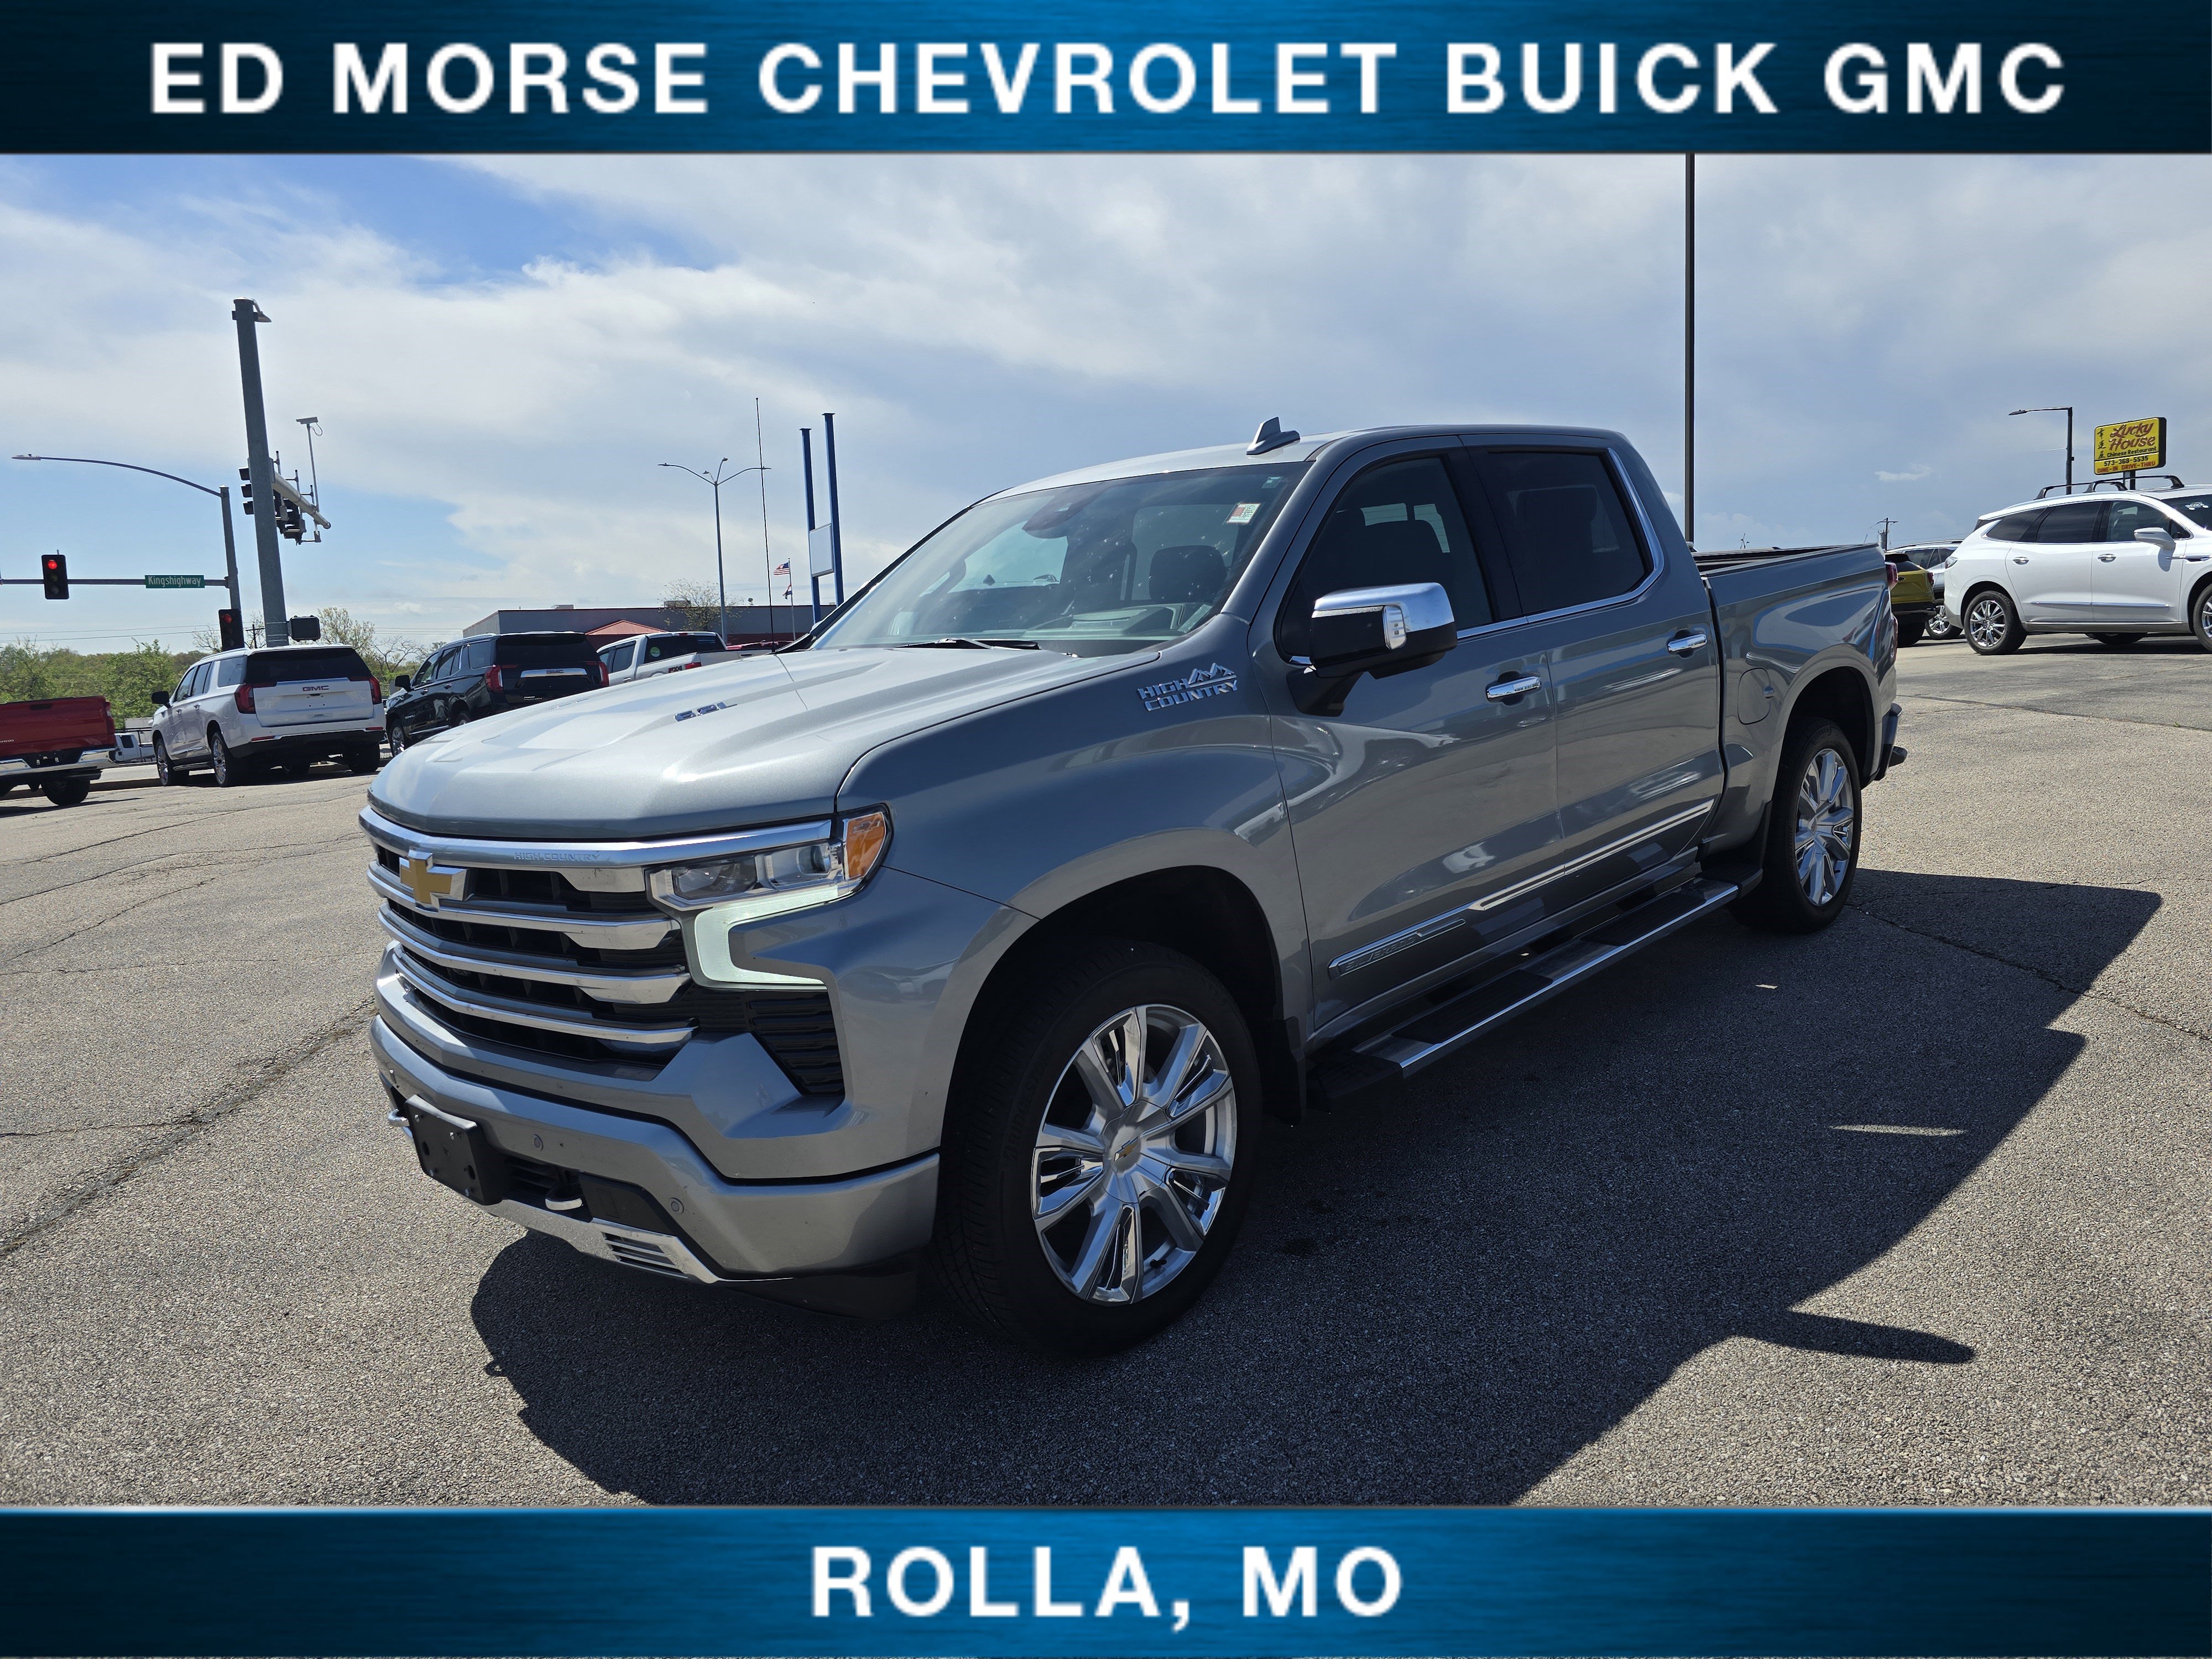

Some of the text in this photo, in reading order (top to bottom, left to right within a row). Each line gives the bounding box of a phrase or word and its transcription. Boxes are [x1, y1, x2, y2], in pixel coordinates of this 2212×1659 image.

[2110, 422, 2154, 439] Lucky
[2109, 436, 2156, 451] House
[2127, 446, 2157, 455] Restaurant
[2097, 461, 2156, 474] DINE-IN DRIVE-THRU
[148, 576, 201, 587] Kingshighway
[1137, 678, 1190, 700] HIGH
[1145, 680, 1238, 711] COUNTRY
[514, 852, 601, 862] HIGH COUNTRY
